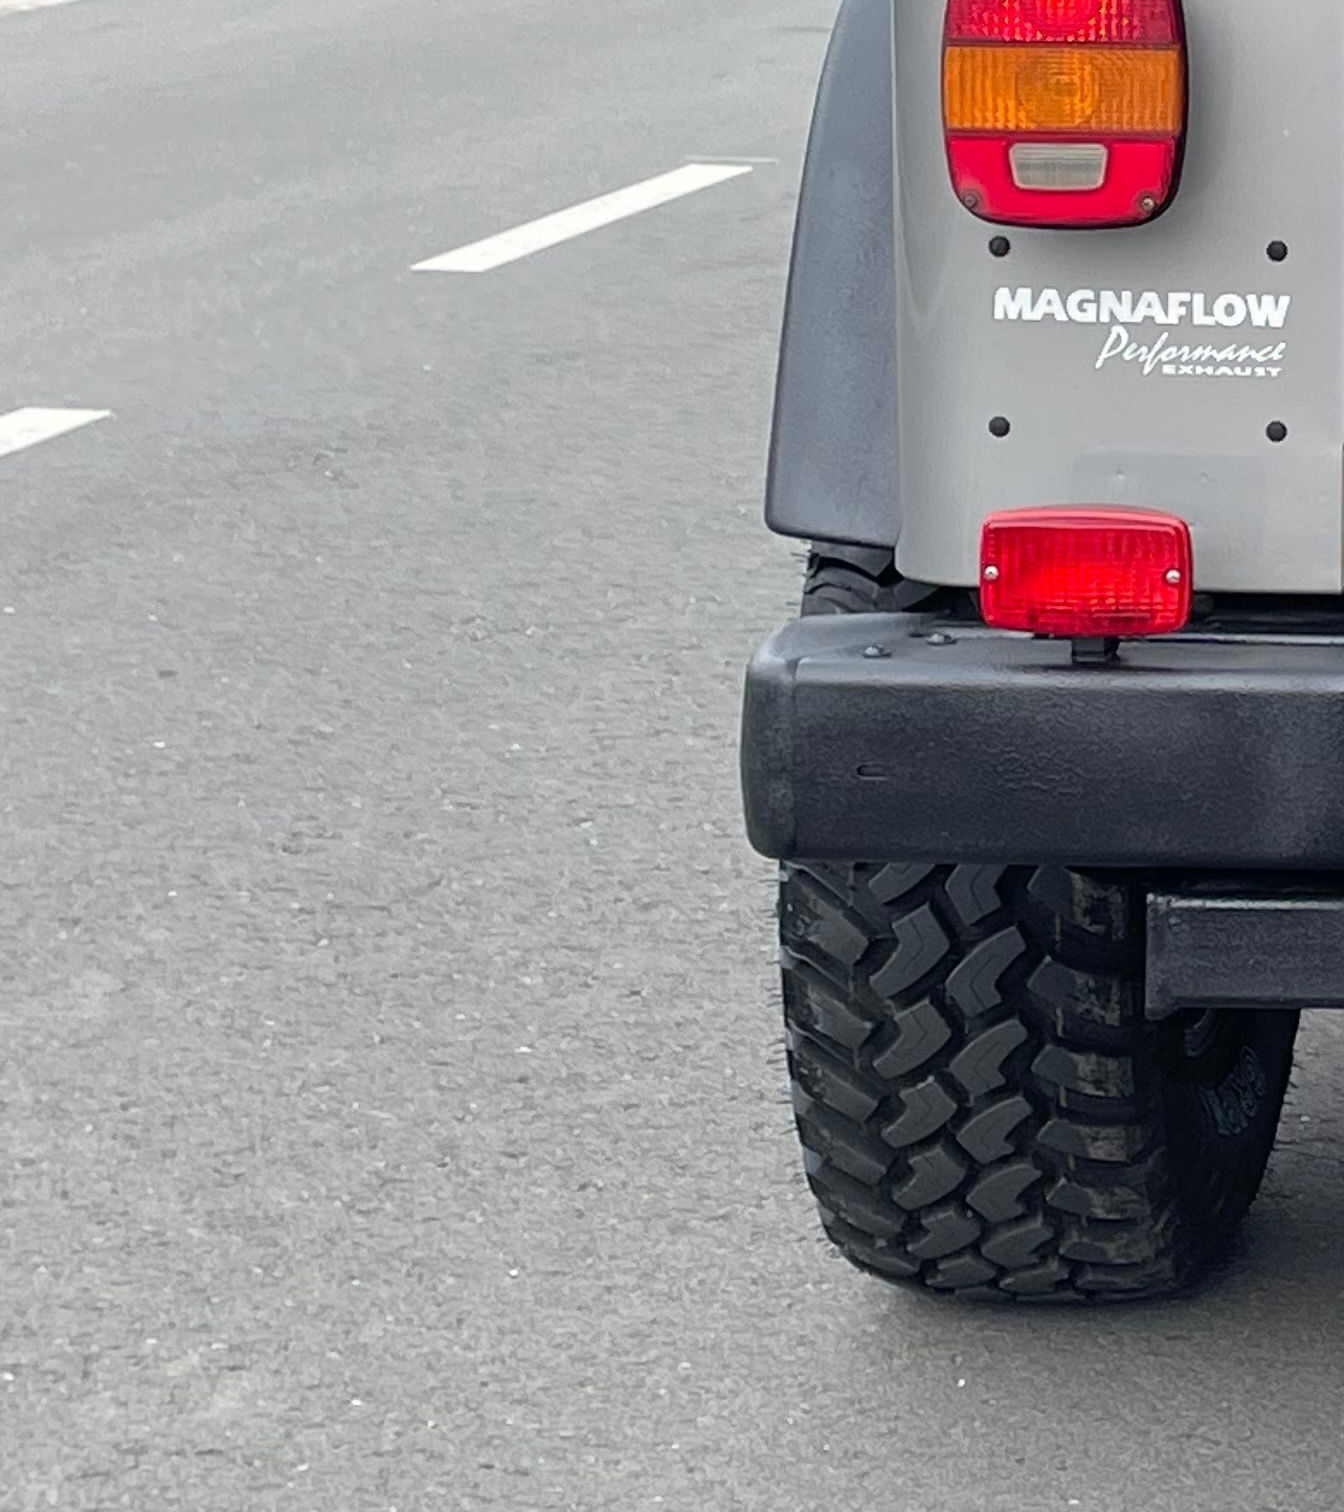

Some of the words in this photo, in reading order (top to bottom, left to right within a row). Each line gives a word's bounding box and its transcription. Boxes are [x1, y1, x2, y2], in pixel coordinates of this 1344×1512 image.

[993, 286, 1291, 328] MAGNAFLOW
[1095, 324, 1287, 376] Performance
[1162, 365, 1283, 377] EXHAUST
